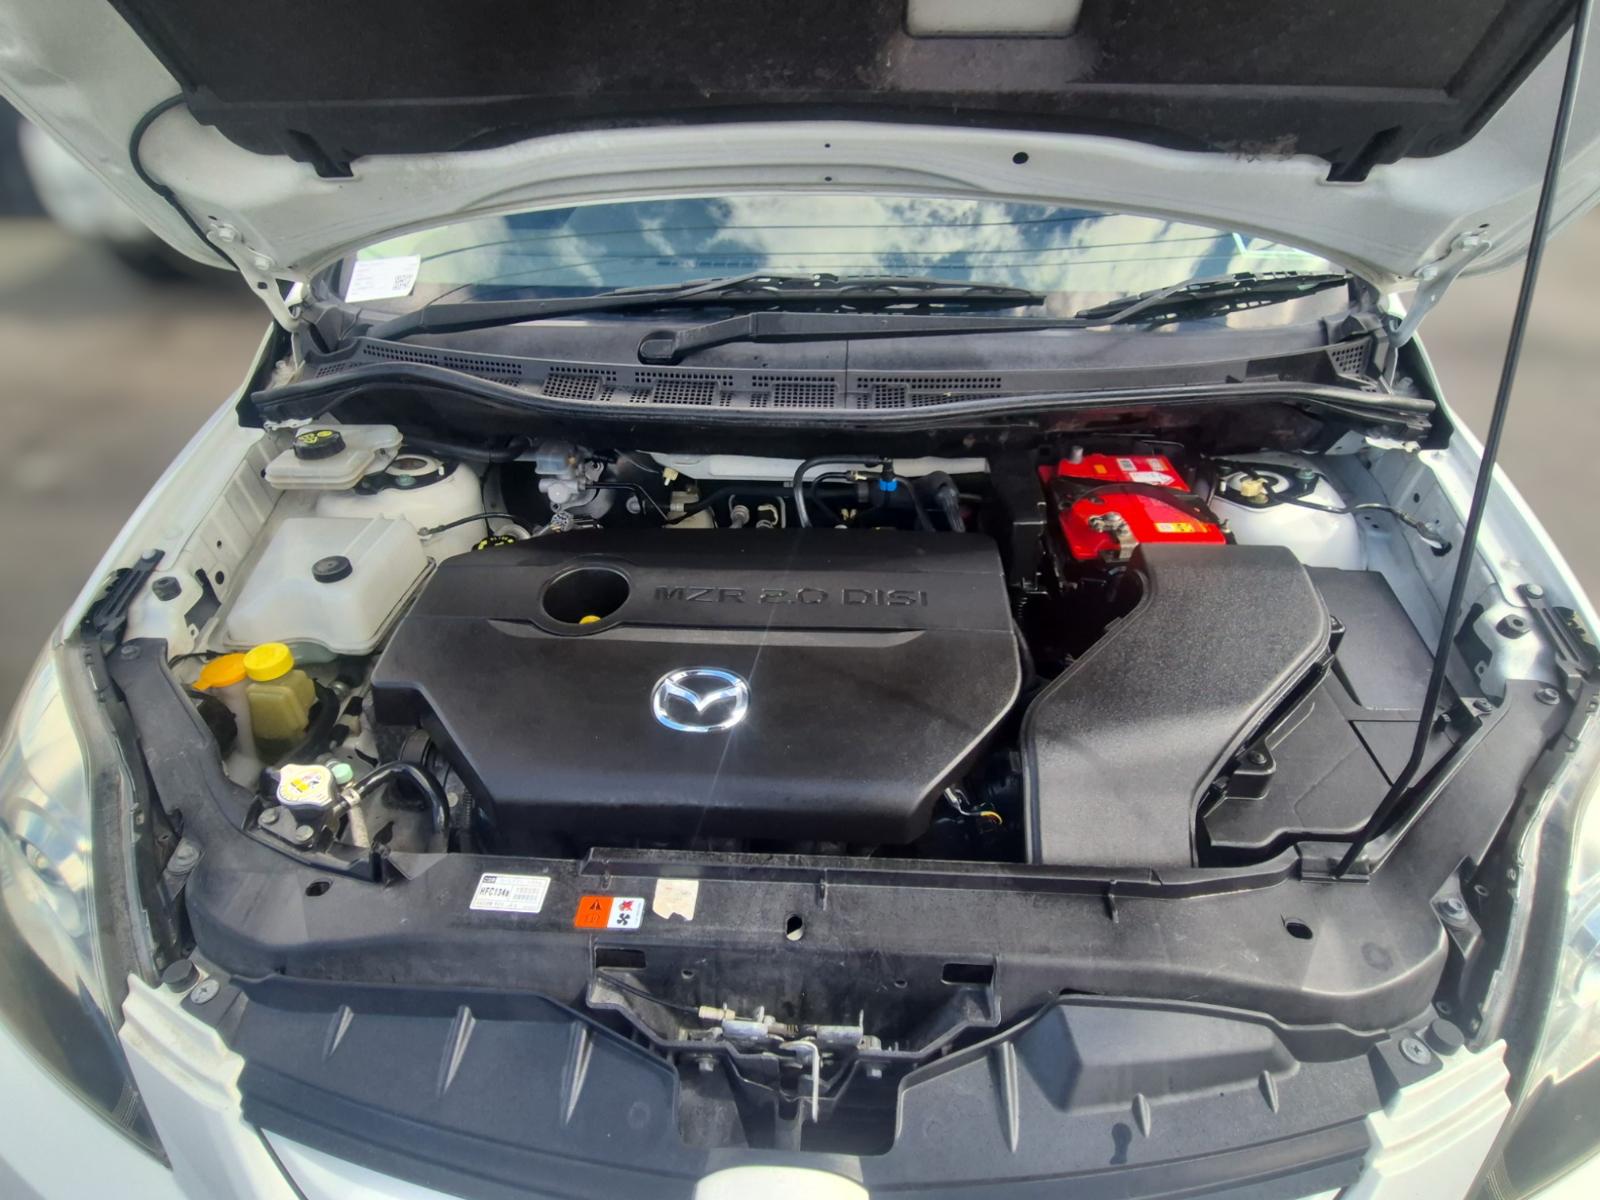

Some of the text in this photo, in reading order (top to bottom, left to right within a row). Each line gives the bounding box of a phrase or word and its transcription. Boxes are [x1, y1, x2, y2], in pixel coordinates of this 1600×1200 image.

[654, 585, 928, 607] MZR 2.0 DISI
